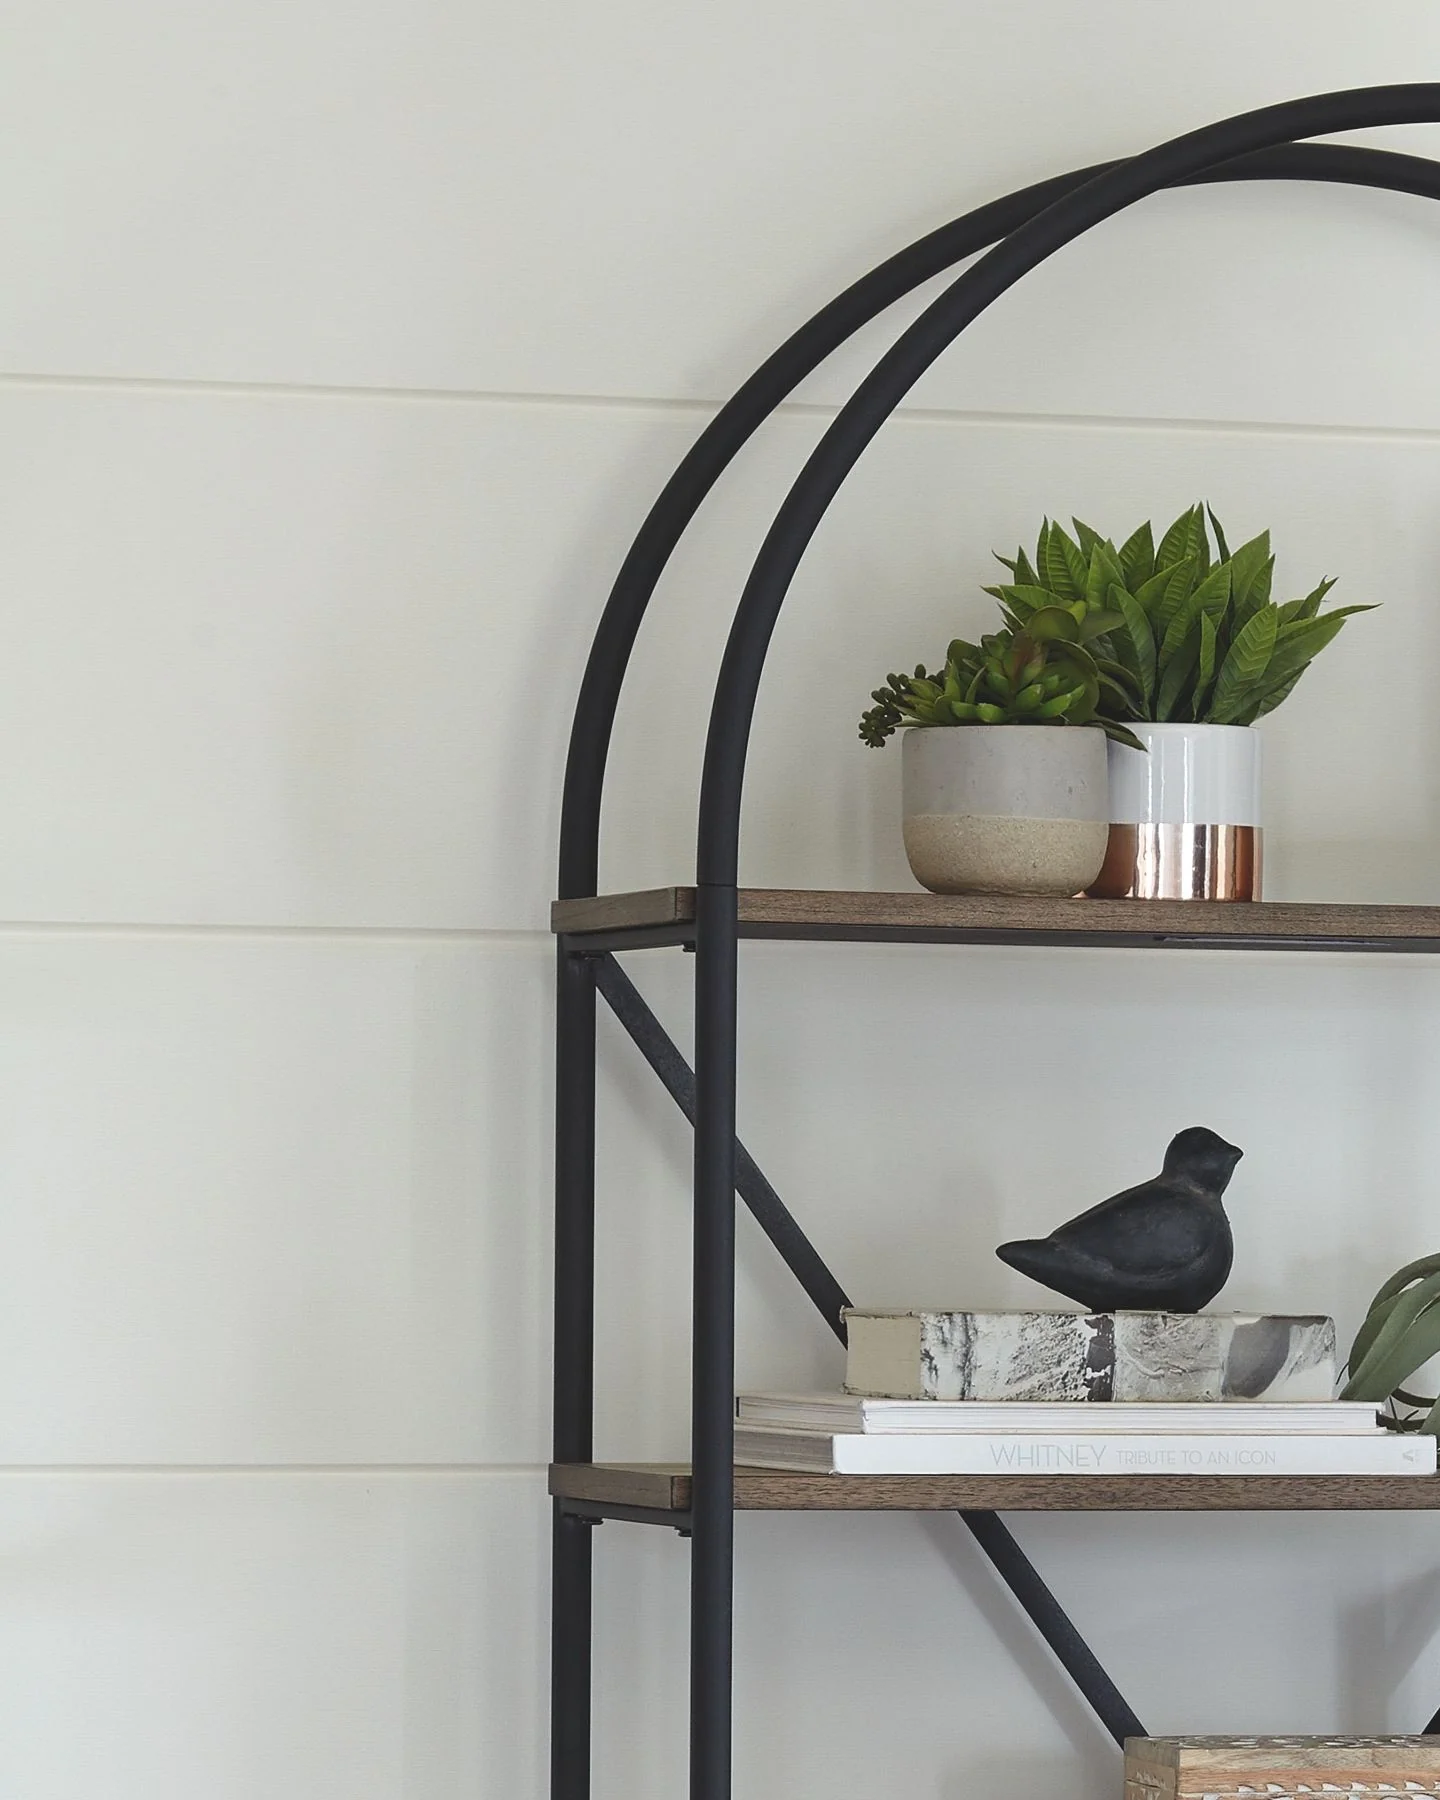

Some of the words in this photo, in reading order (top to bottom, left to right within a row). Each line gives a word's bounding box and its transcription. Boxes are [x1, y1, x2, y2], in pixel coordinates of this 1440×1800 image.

[990, 1444, 1107, 1467] WHITNEY
[1116, 1450, 1177, 1465] TRIBUTE
[1182, 1450, 1203, 1465] TO
[1207, 1450, 1230, 1465] AN
[1235, 1450, 1276, 1465] ICON
